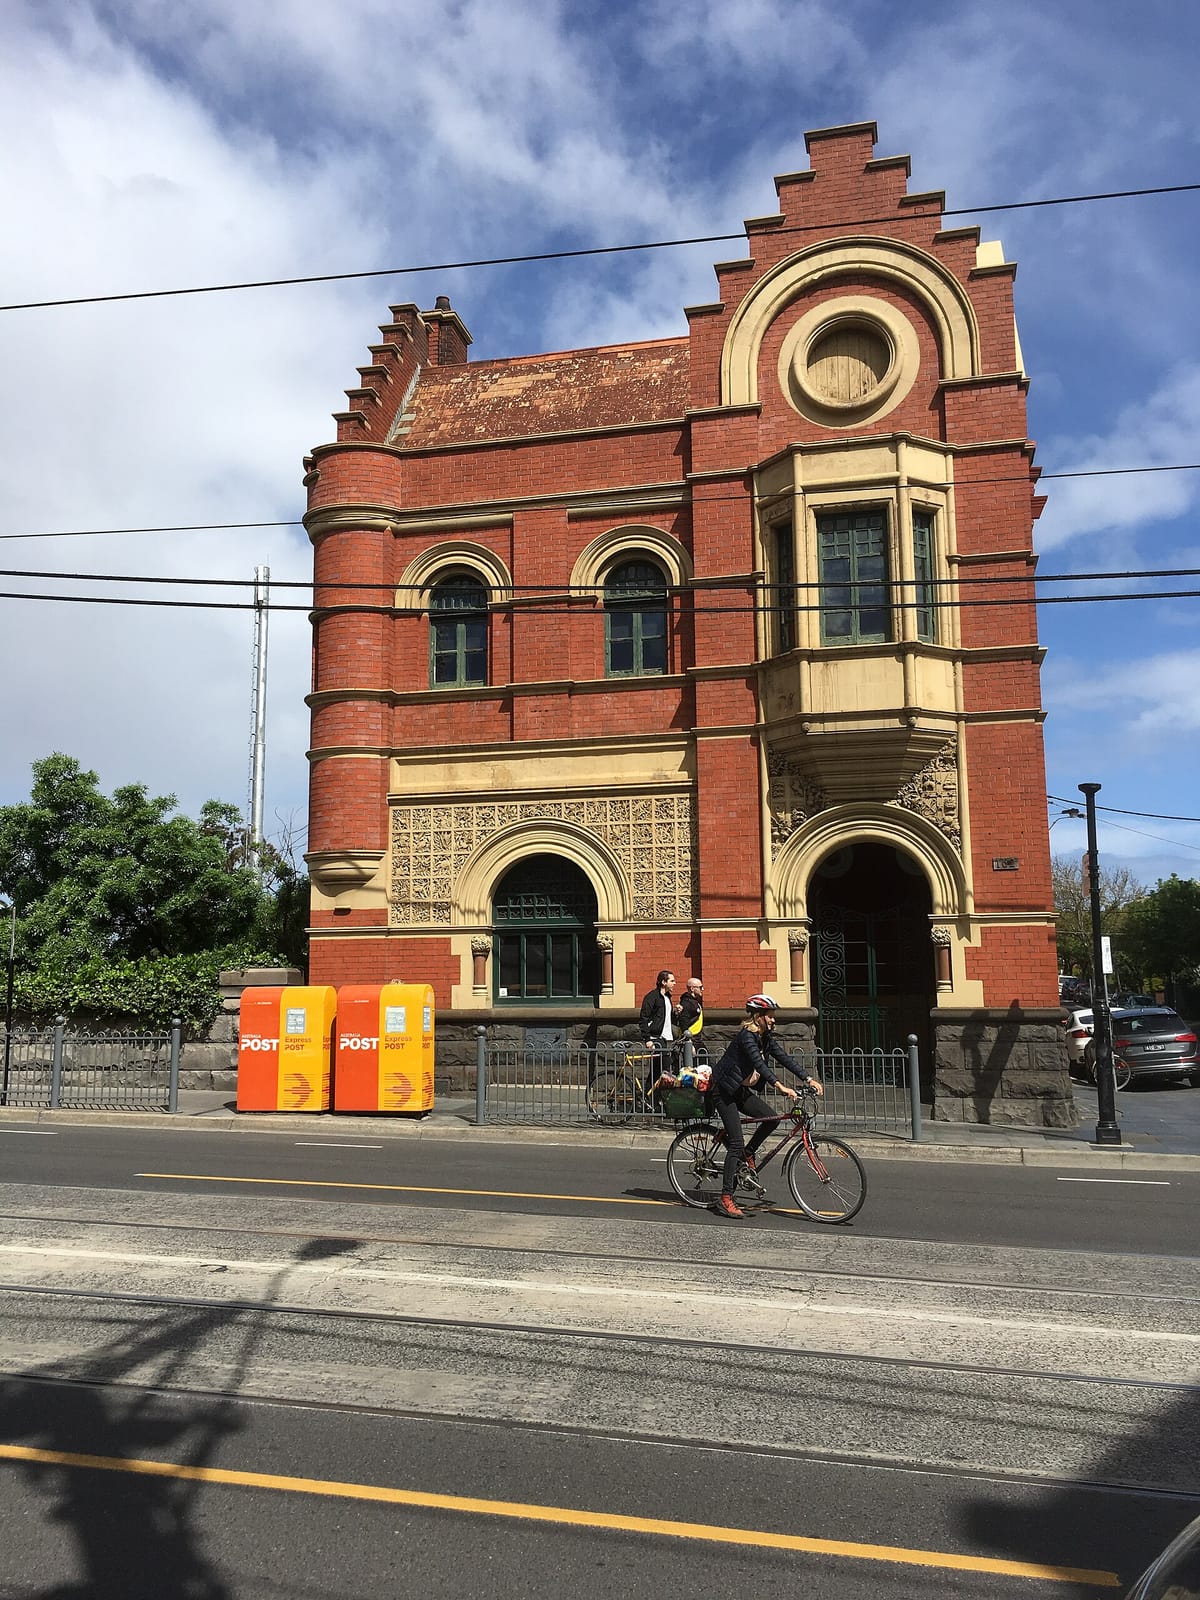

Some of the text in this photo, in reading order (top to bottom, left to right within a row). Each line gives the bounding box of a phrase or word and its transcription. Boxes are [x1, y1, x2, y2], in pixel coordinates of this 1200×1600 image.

[241, 1038, 279, 1051] POST
[340, 1037, 379, 1050] POST
[384, 1035, 412, 1043] Express
